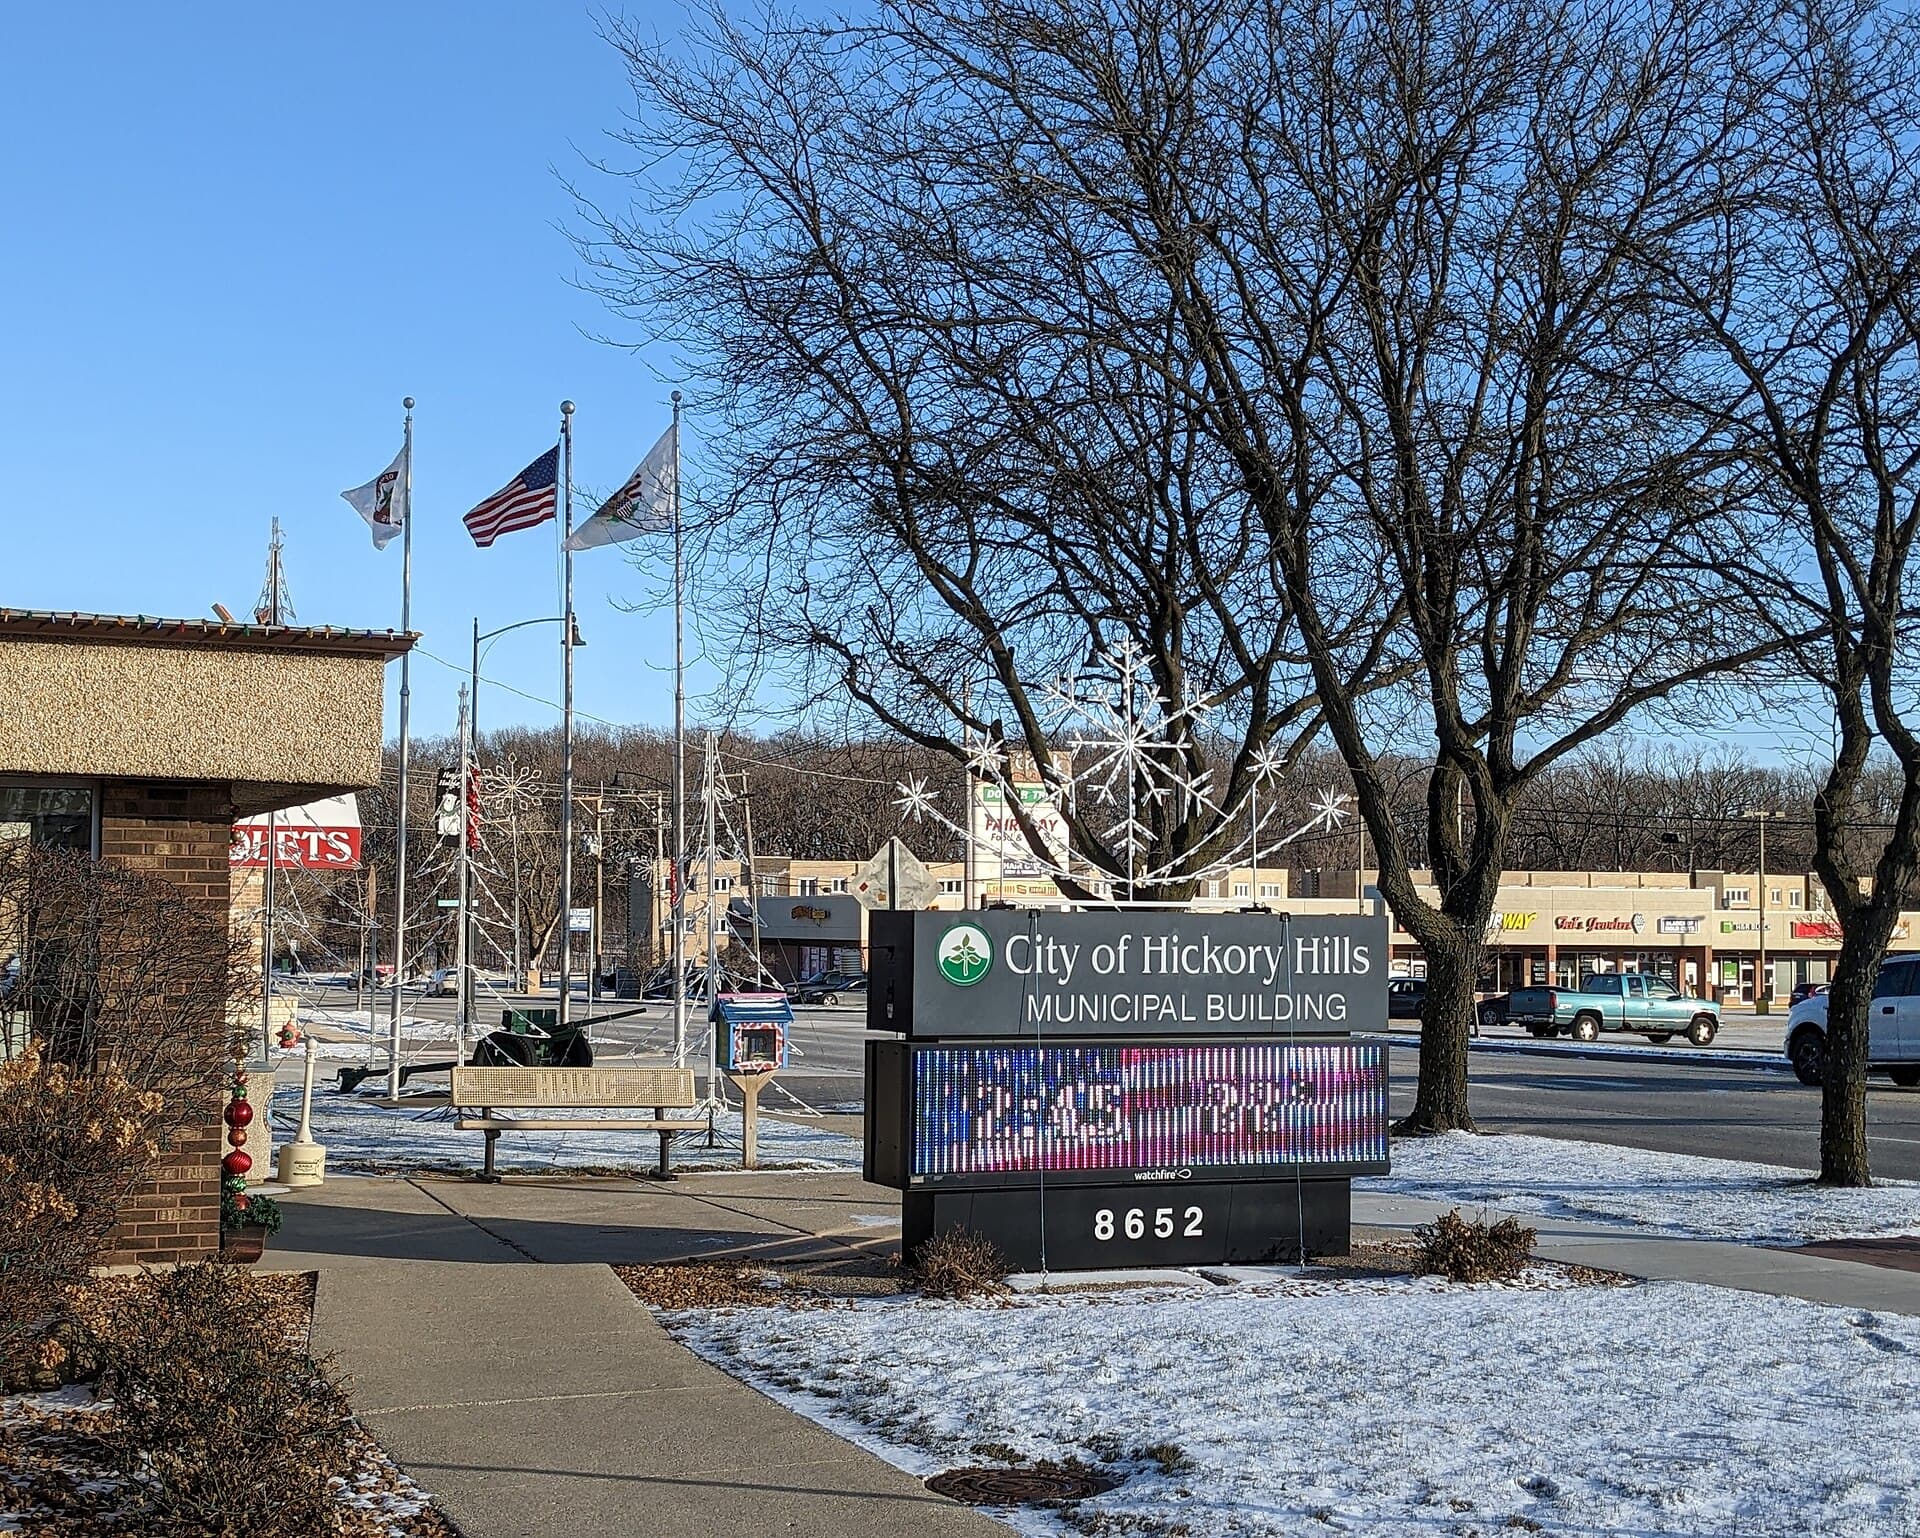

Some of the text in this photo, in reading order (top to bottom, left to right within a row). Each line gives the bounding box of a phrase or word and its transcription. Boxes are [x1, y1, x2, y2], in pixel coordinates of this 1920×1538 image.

[985, 818, 1058, 832] FAIRAY
[1005, 934, 1370, 986] City of Hickory Hills
[1027, 993, 1347, 1022] MUNICIPAL BUILDING
[1134, 1168, 1177, 1180] watchfire
[1094, 1206, 1204, 1241] 8652
